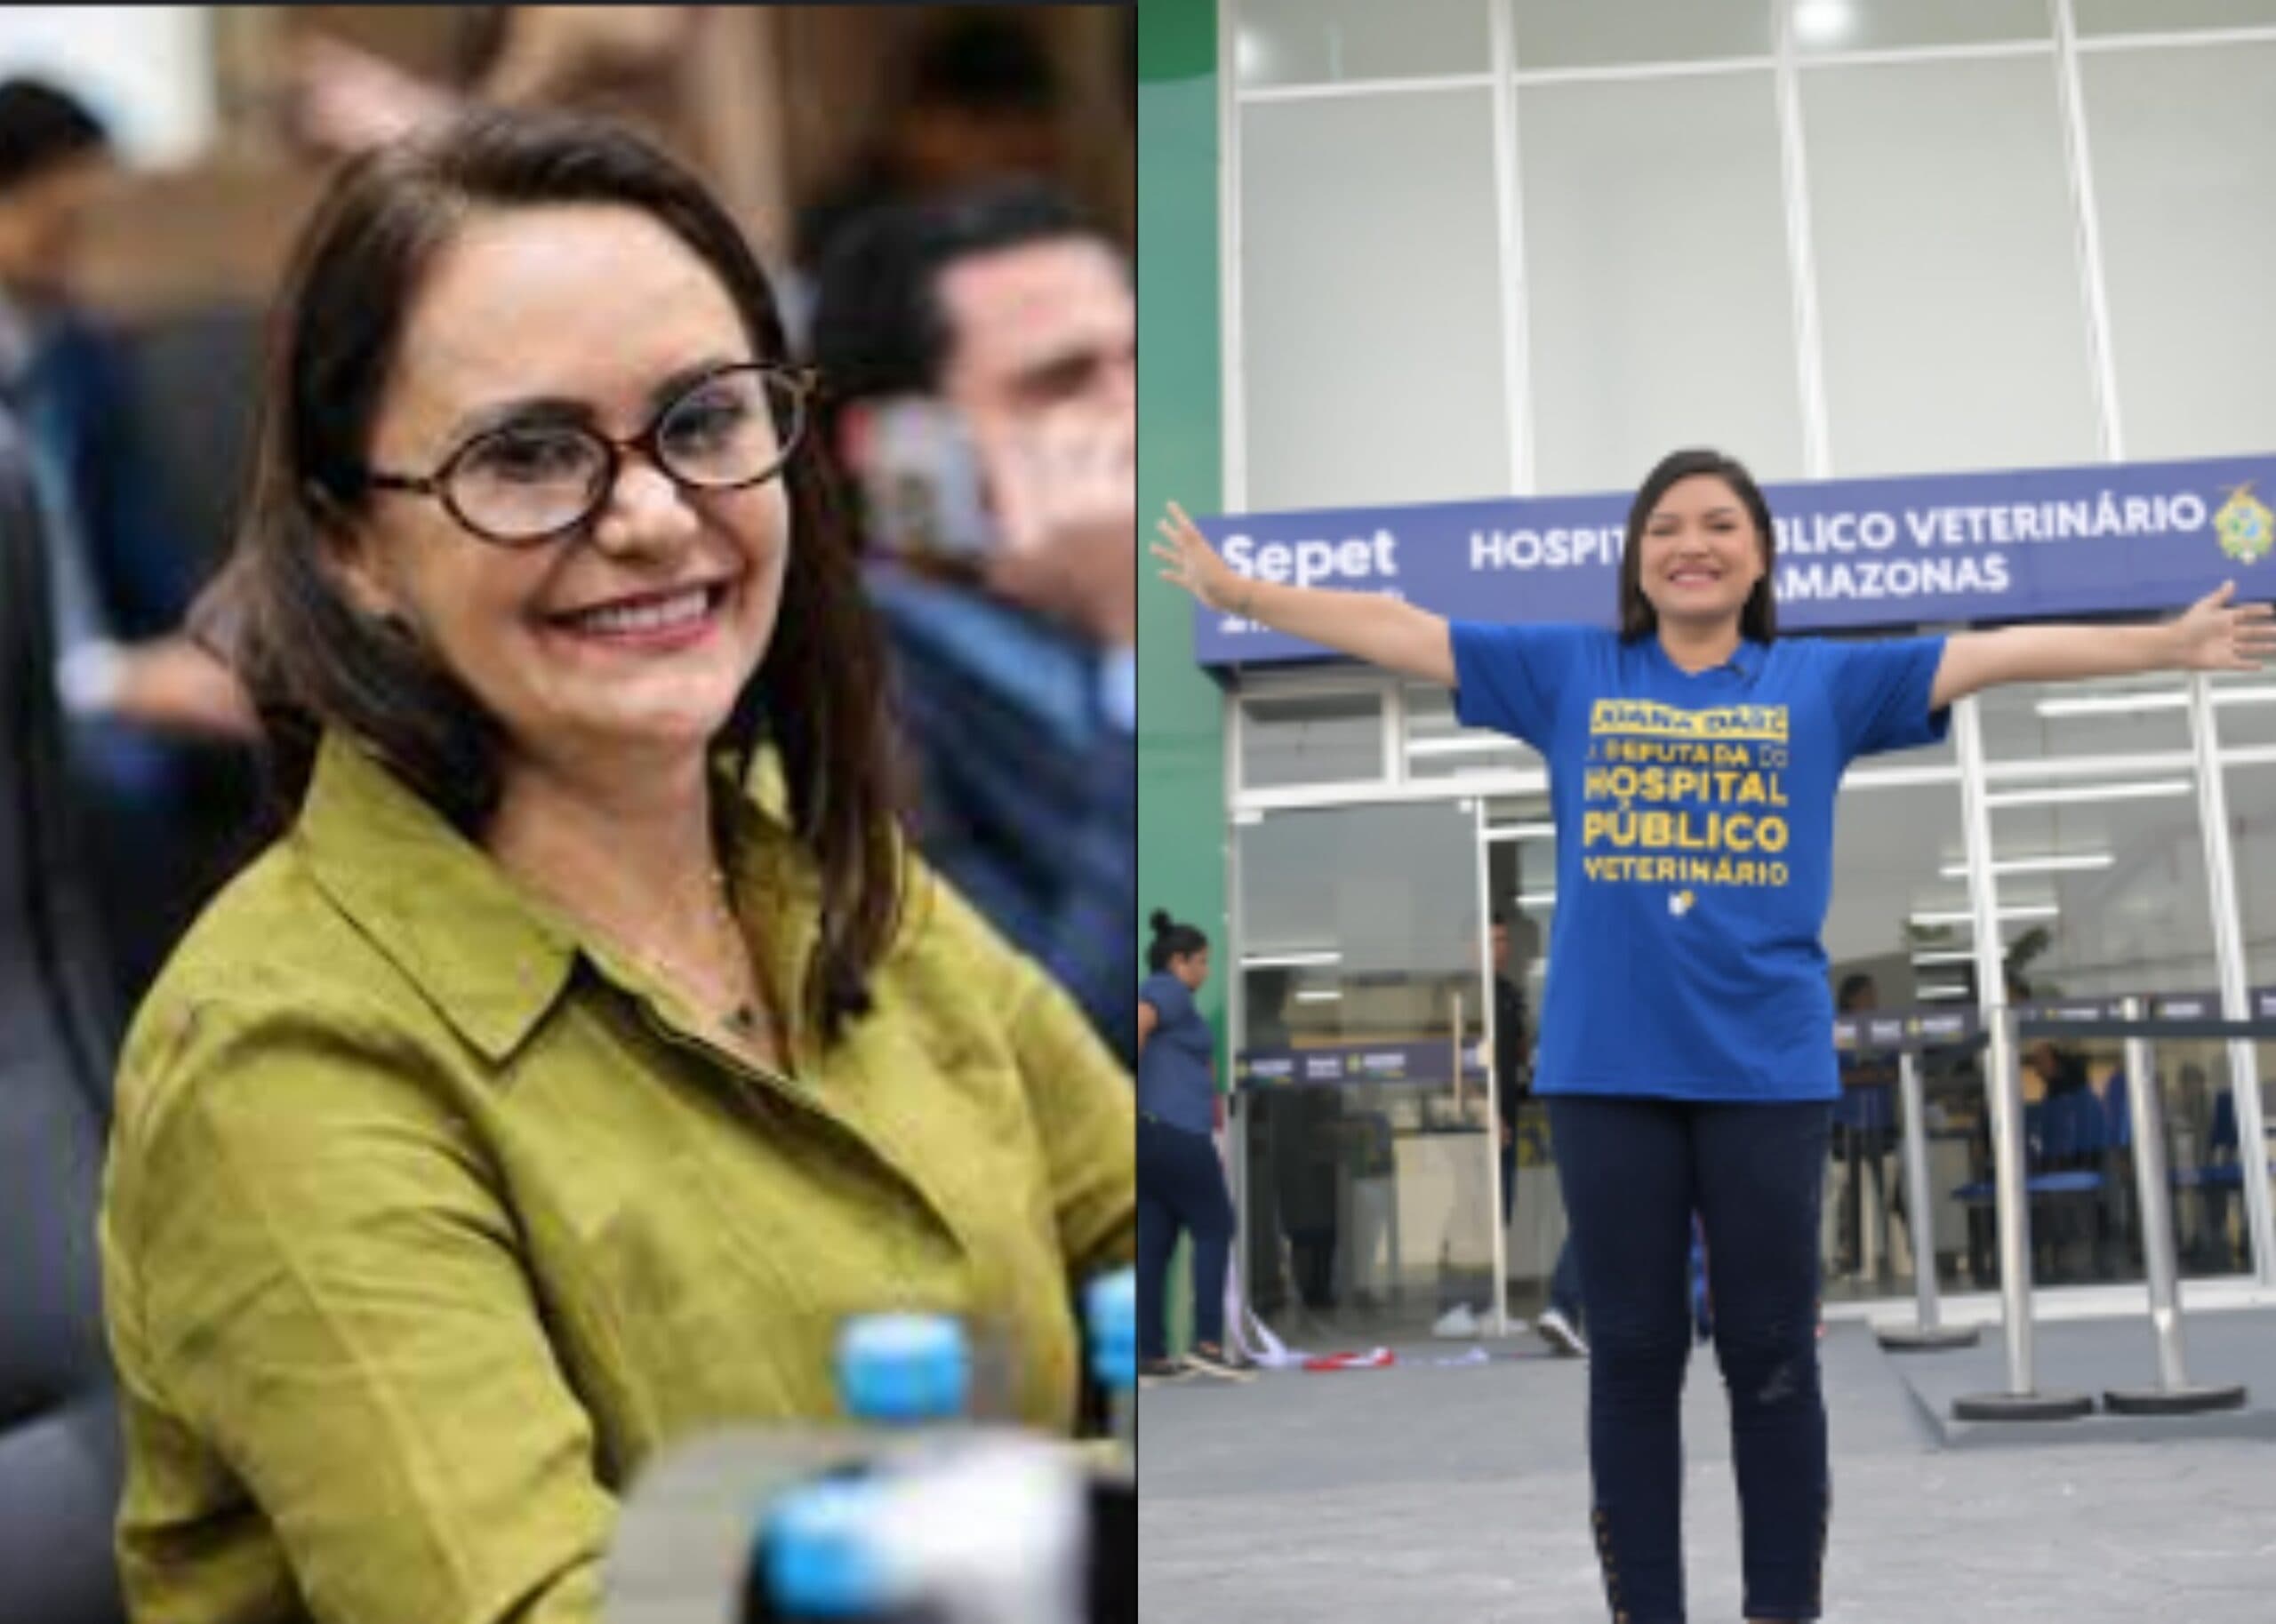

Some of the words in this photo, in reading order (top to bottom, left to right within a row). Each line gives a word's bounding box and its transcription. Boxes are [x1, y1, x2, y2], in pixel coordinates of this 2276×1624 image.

[1470, 525, 1629, 571] HOSPIT
[1905, 489, 2208, 548] VETERINÁRIO
[1222, 529, 1398, 589] Sepet
[1584, 767, 1787, 804] HOSPITAL
[1583, 798, 1789, 853] PÚBLICO
[1583, 855, 1788, 884] VETERINÁRIO
